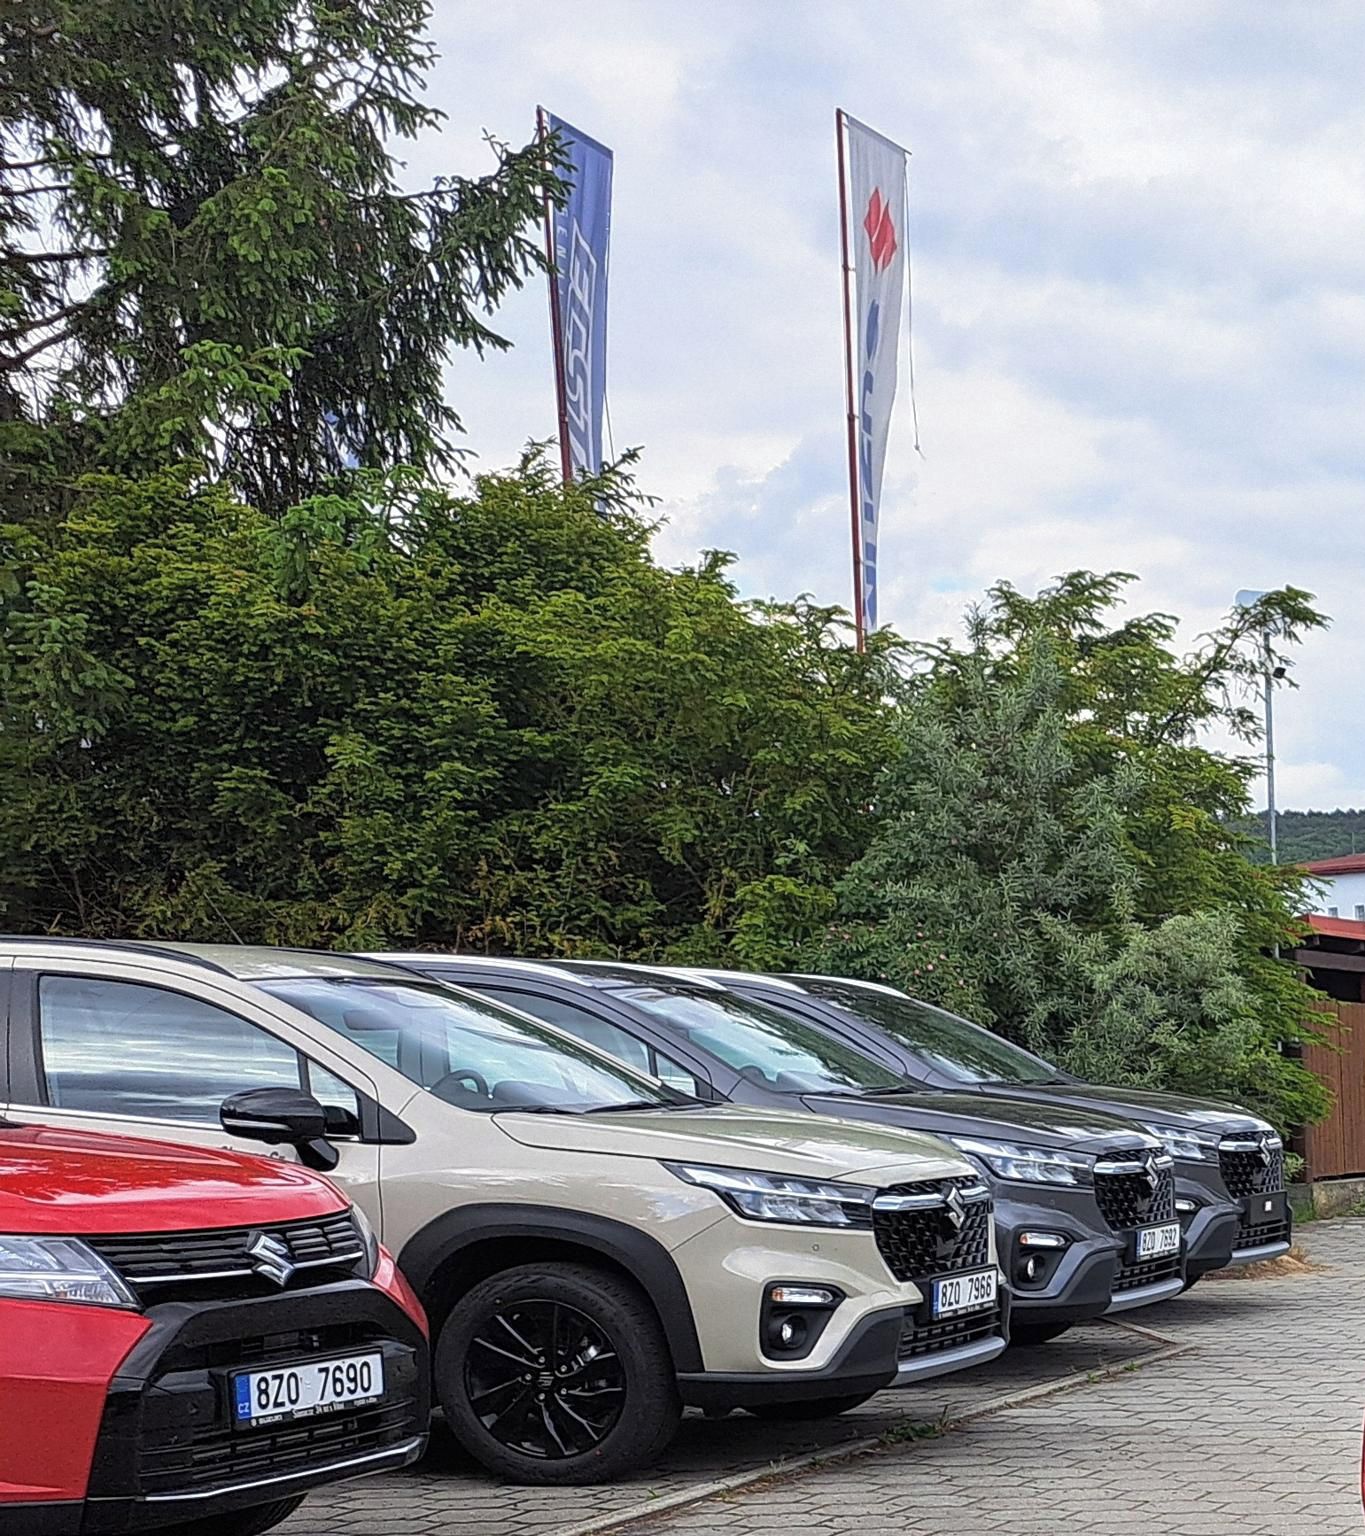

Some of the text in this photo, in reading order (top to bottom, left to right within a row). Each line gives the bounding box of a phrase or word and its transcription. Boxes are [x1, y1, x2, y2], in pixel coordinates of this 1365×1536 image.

[968, 1274, 992, 1303] 7966
[256, 1360, 372, 1410] 8Z0 7690
